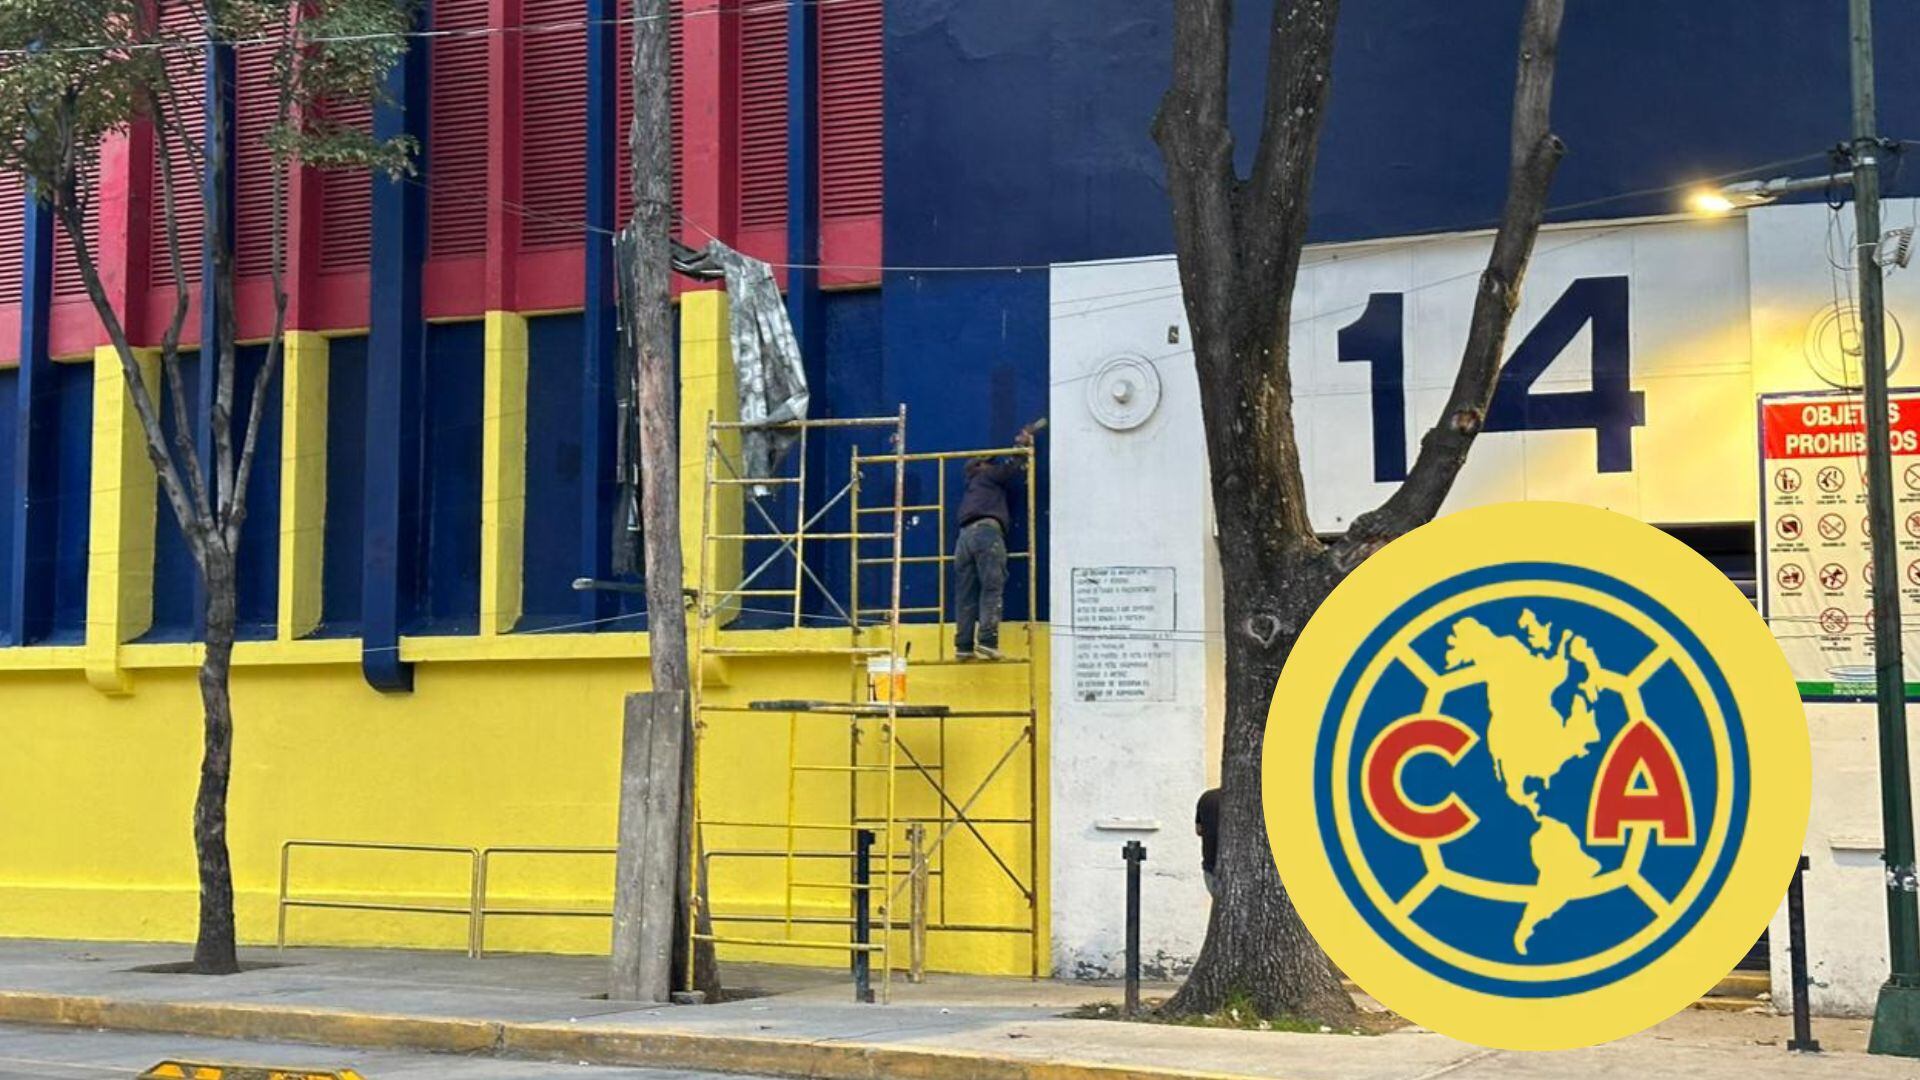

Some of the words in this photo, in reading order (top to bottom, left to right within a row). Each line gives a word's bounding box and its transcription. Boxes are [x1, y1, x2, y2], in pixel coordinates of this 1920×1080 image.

[1338, 275, 1645, 482] 14
[1801, 402, 1901, 427] OBJETS
[1785, 430, 1918, 455] PROHIBOS
